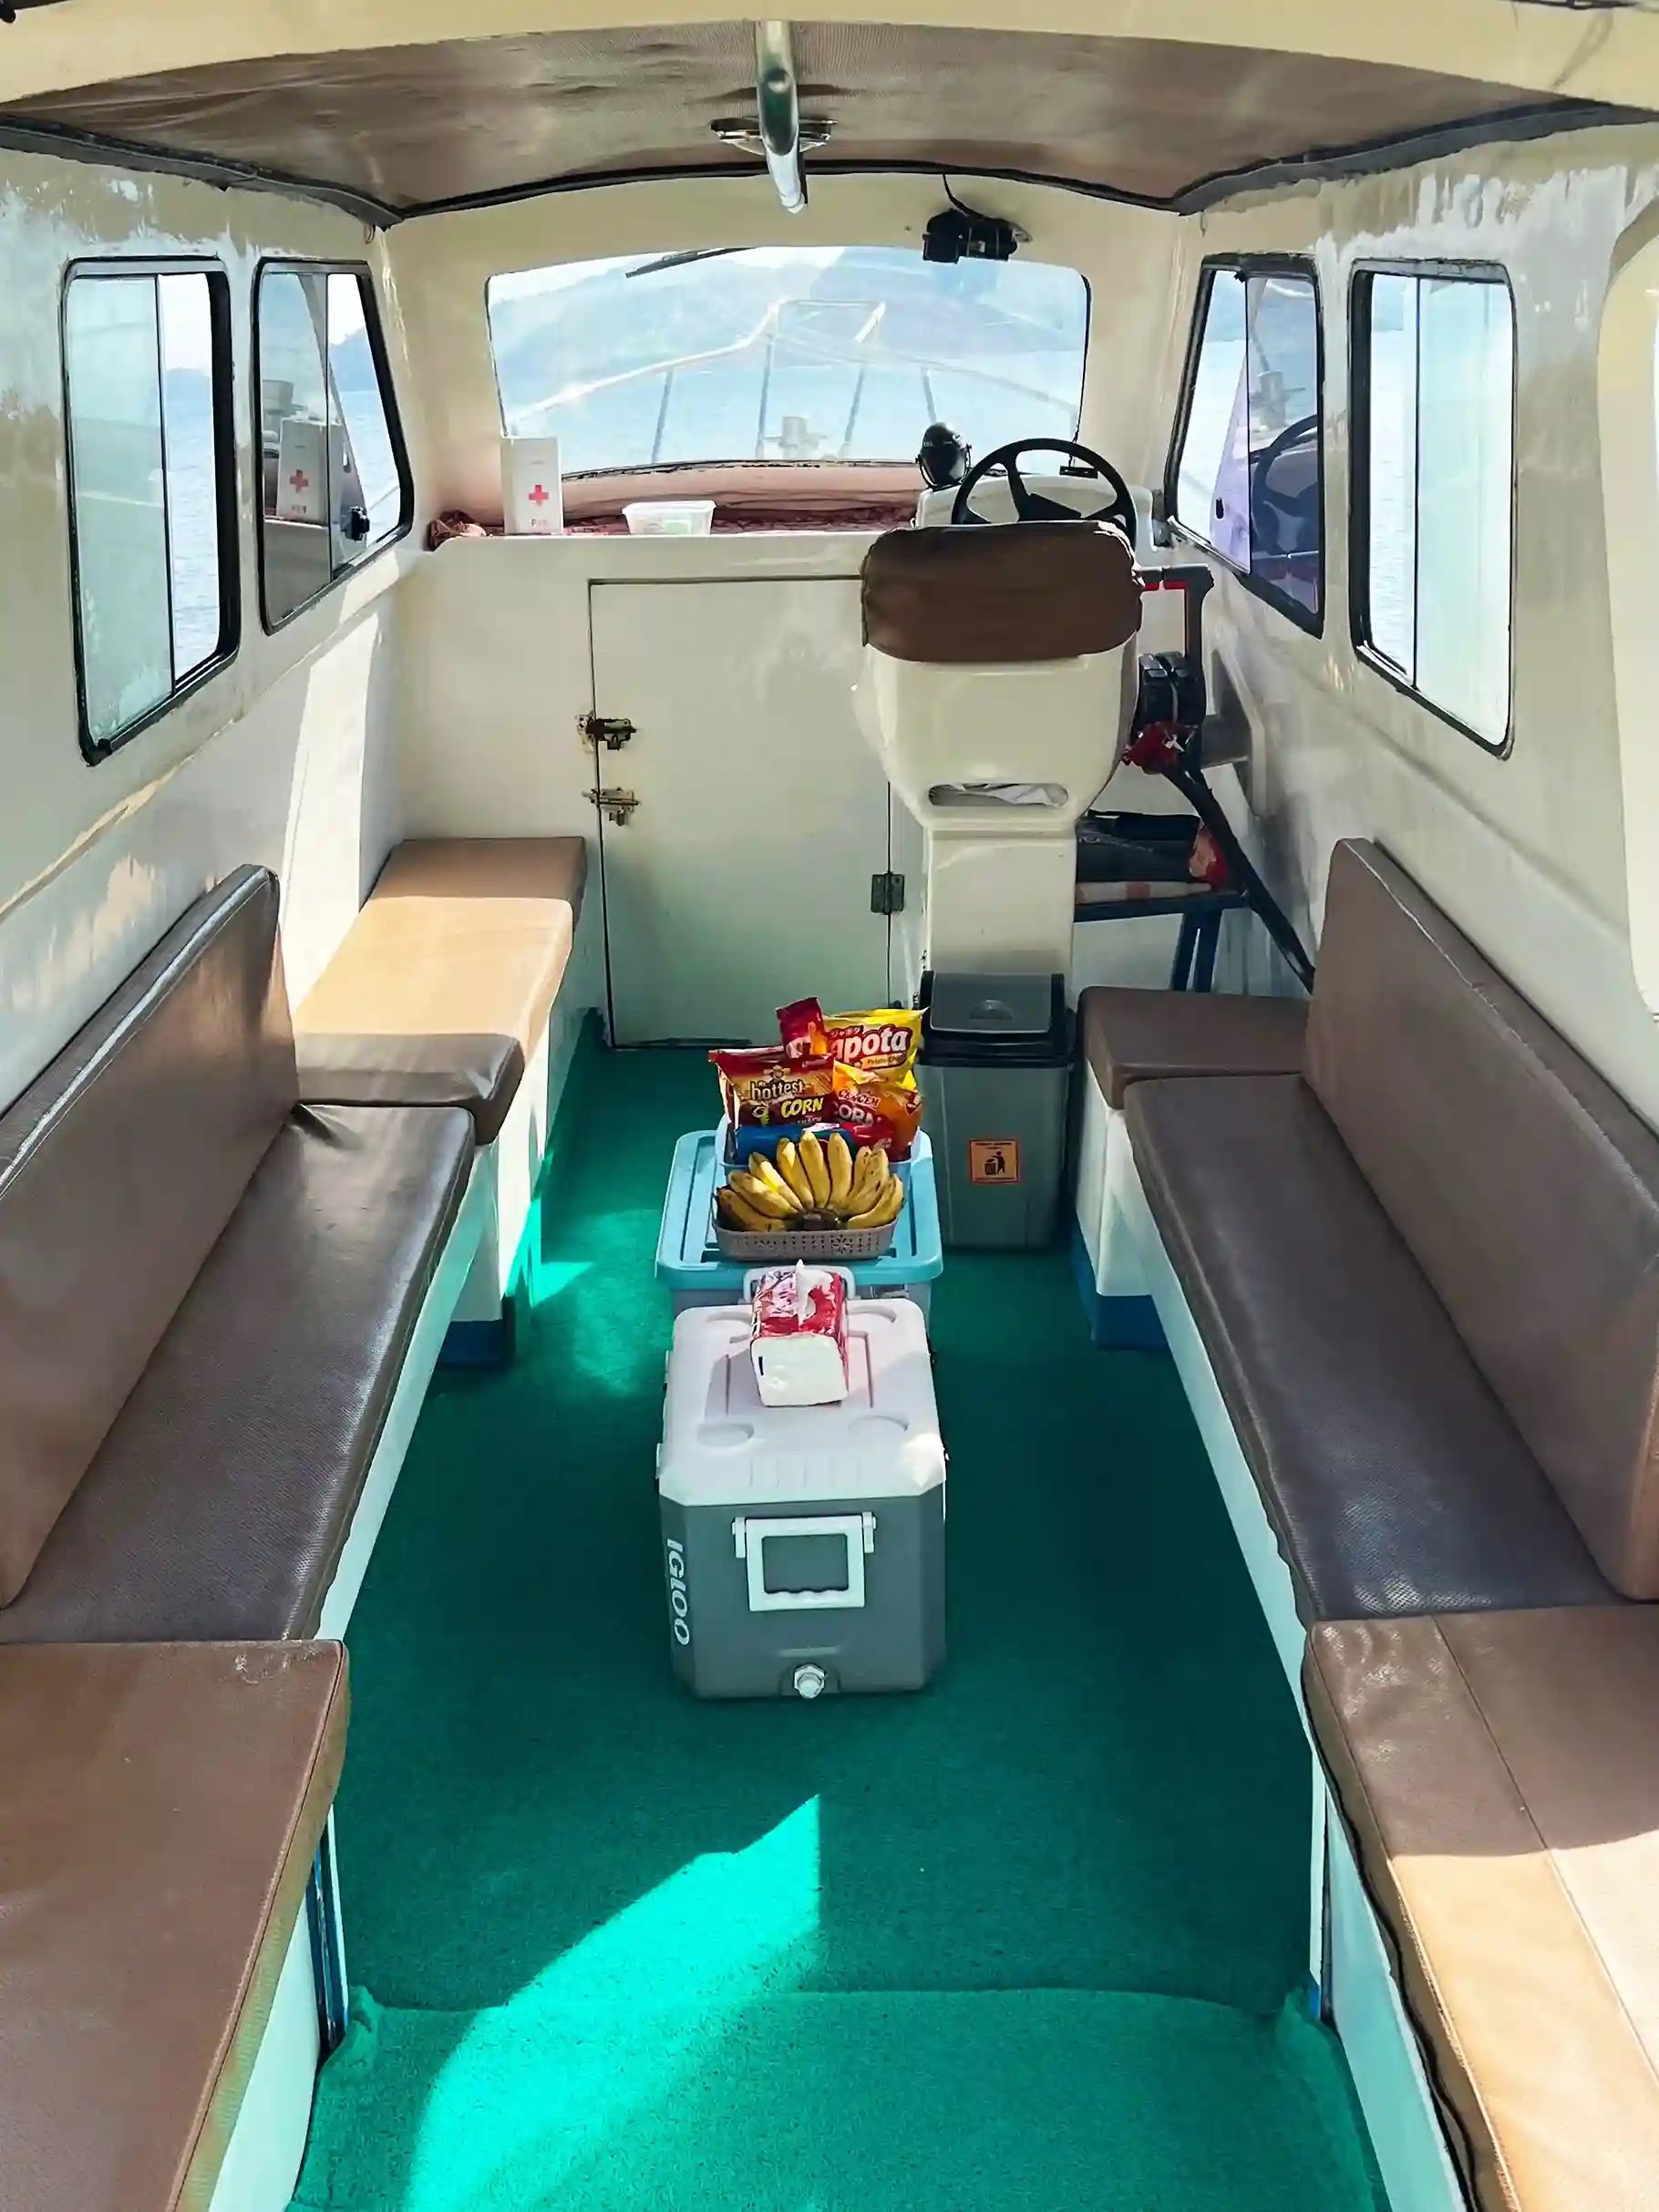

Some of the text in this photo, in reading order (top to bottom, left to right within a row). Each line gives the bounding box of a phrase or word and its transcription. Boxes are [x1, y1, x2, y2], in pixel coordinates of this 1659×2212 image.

[830, 1027, 909, 1065] apota
[751, 1079, 804, 1100] hottest
[780, 1096, 824, 1118] CORN
[666, 1538, 690, 1646] IGLOO
